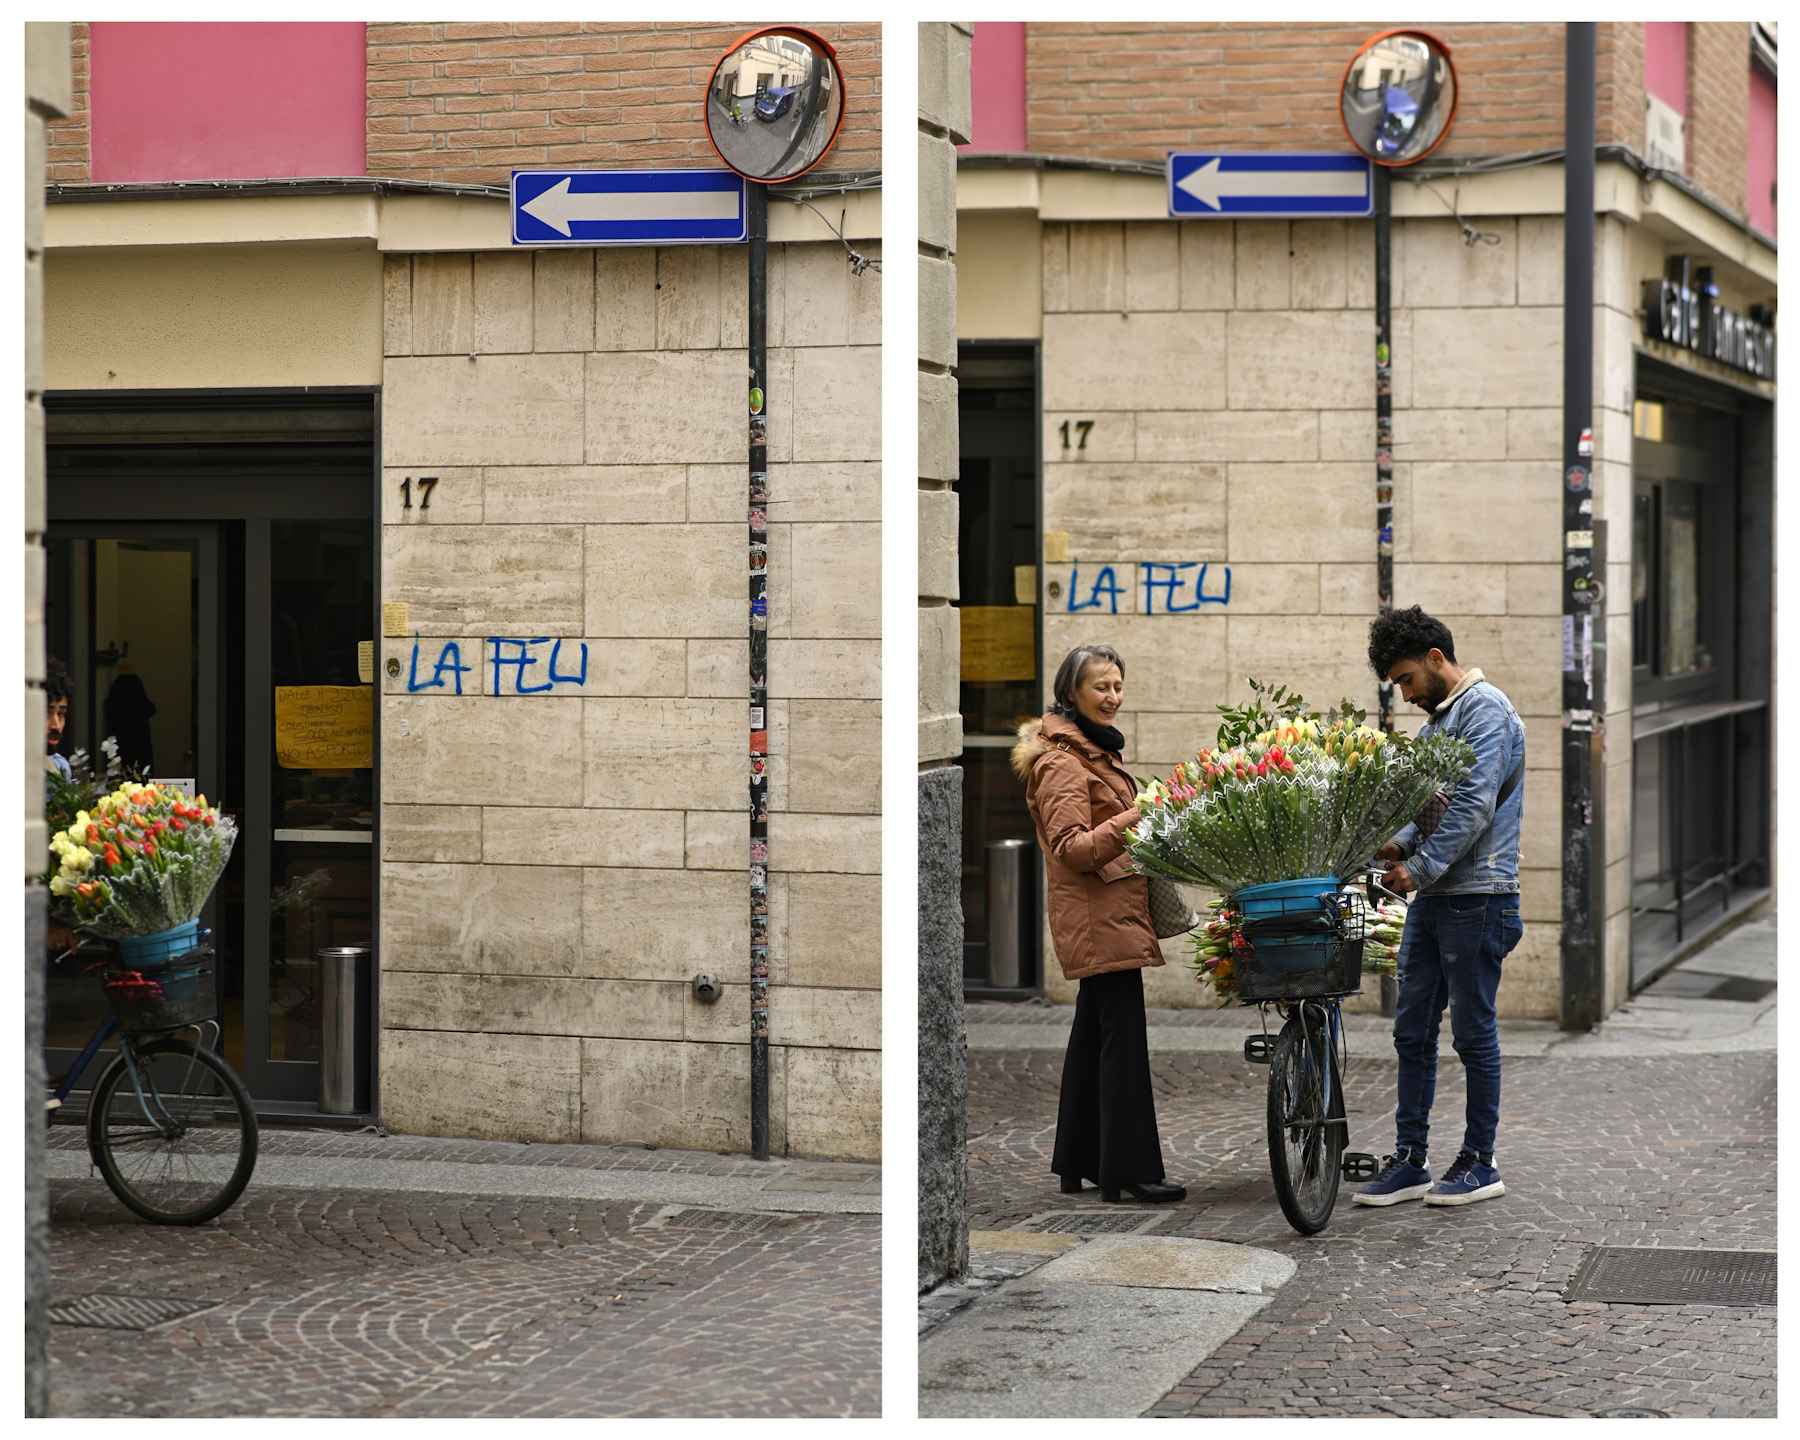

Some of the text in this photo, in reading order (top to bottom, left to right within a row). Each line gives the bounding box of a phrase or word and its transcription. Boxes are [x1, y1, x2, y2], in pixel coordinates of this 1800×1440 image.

[1059, 420, 1095, 449] 17
[400, 477, 439, 508] 17
[1067, 558, 1126, 615] LA
[407, 632, 472, 695] LA
[279, 689, 312, 702] DALLE
[301, 704, 343, 716] OBBLIGO
[292, 728, 327, 742] SOLO
[280, 742, 369, 761] NO ASPORTO
